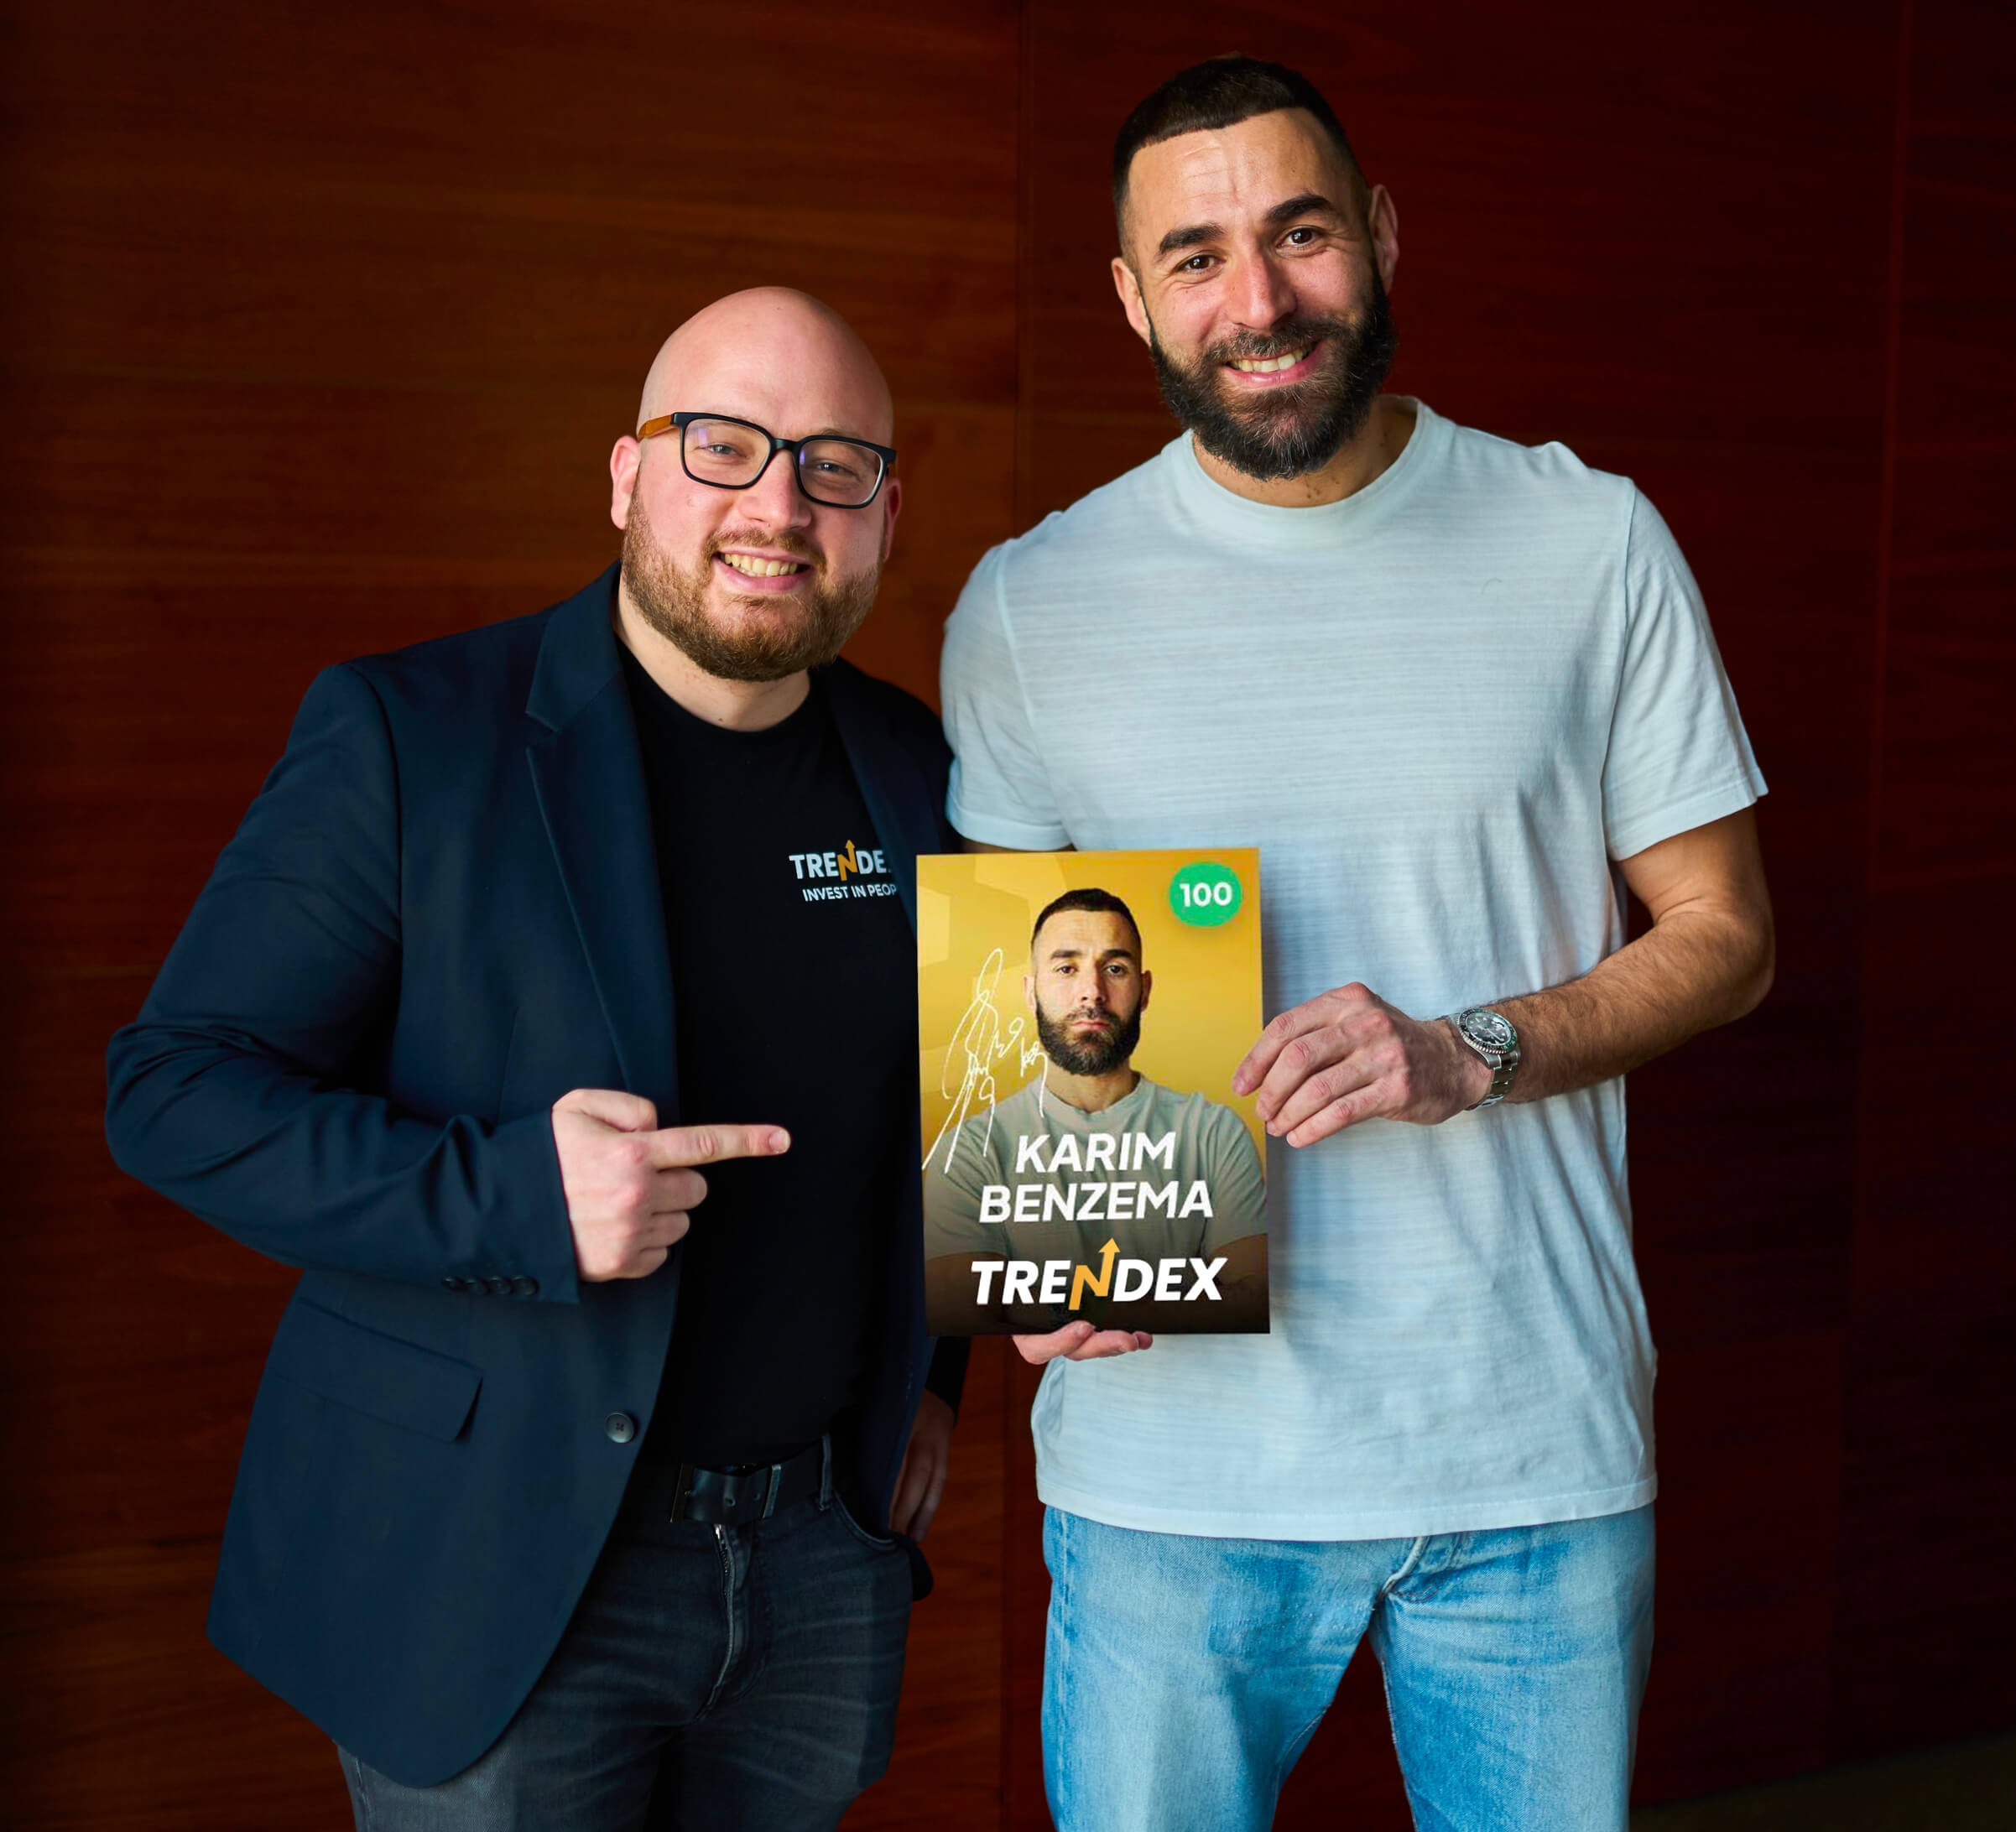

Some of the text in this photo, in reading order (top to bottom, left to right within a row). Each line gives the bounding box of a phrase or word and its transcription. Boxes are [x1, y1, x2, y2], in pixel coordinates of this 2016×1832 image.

[789, 839, 892, 882] TRENDE
[802, 886, 849, 902] INVEST
[851, 885, 867, 898] IN
[1179, 882, 1232, 908] 100
[1015, 1131, 1176, 1174] KARIM
[978, 1179, 1214, 1223] BENZEMA
[970, 1237, 1229, 1310] TRENDEX
